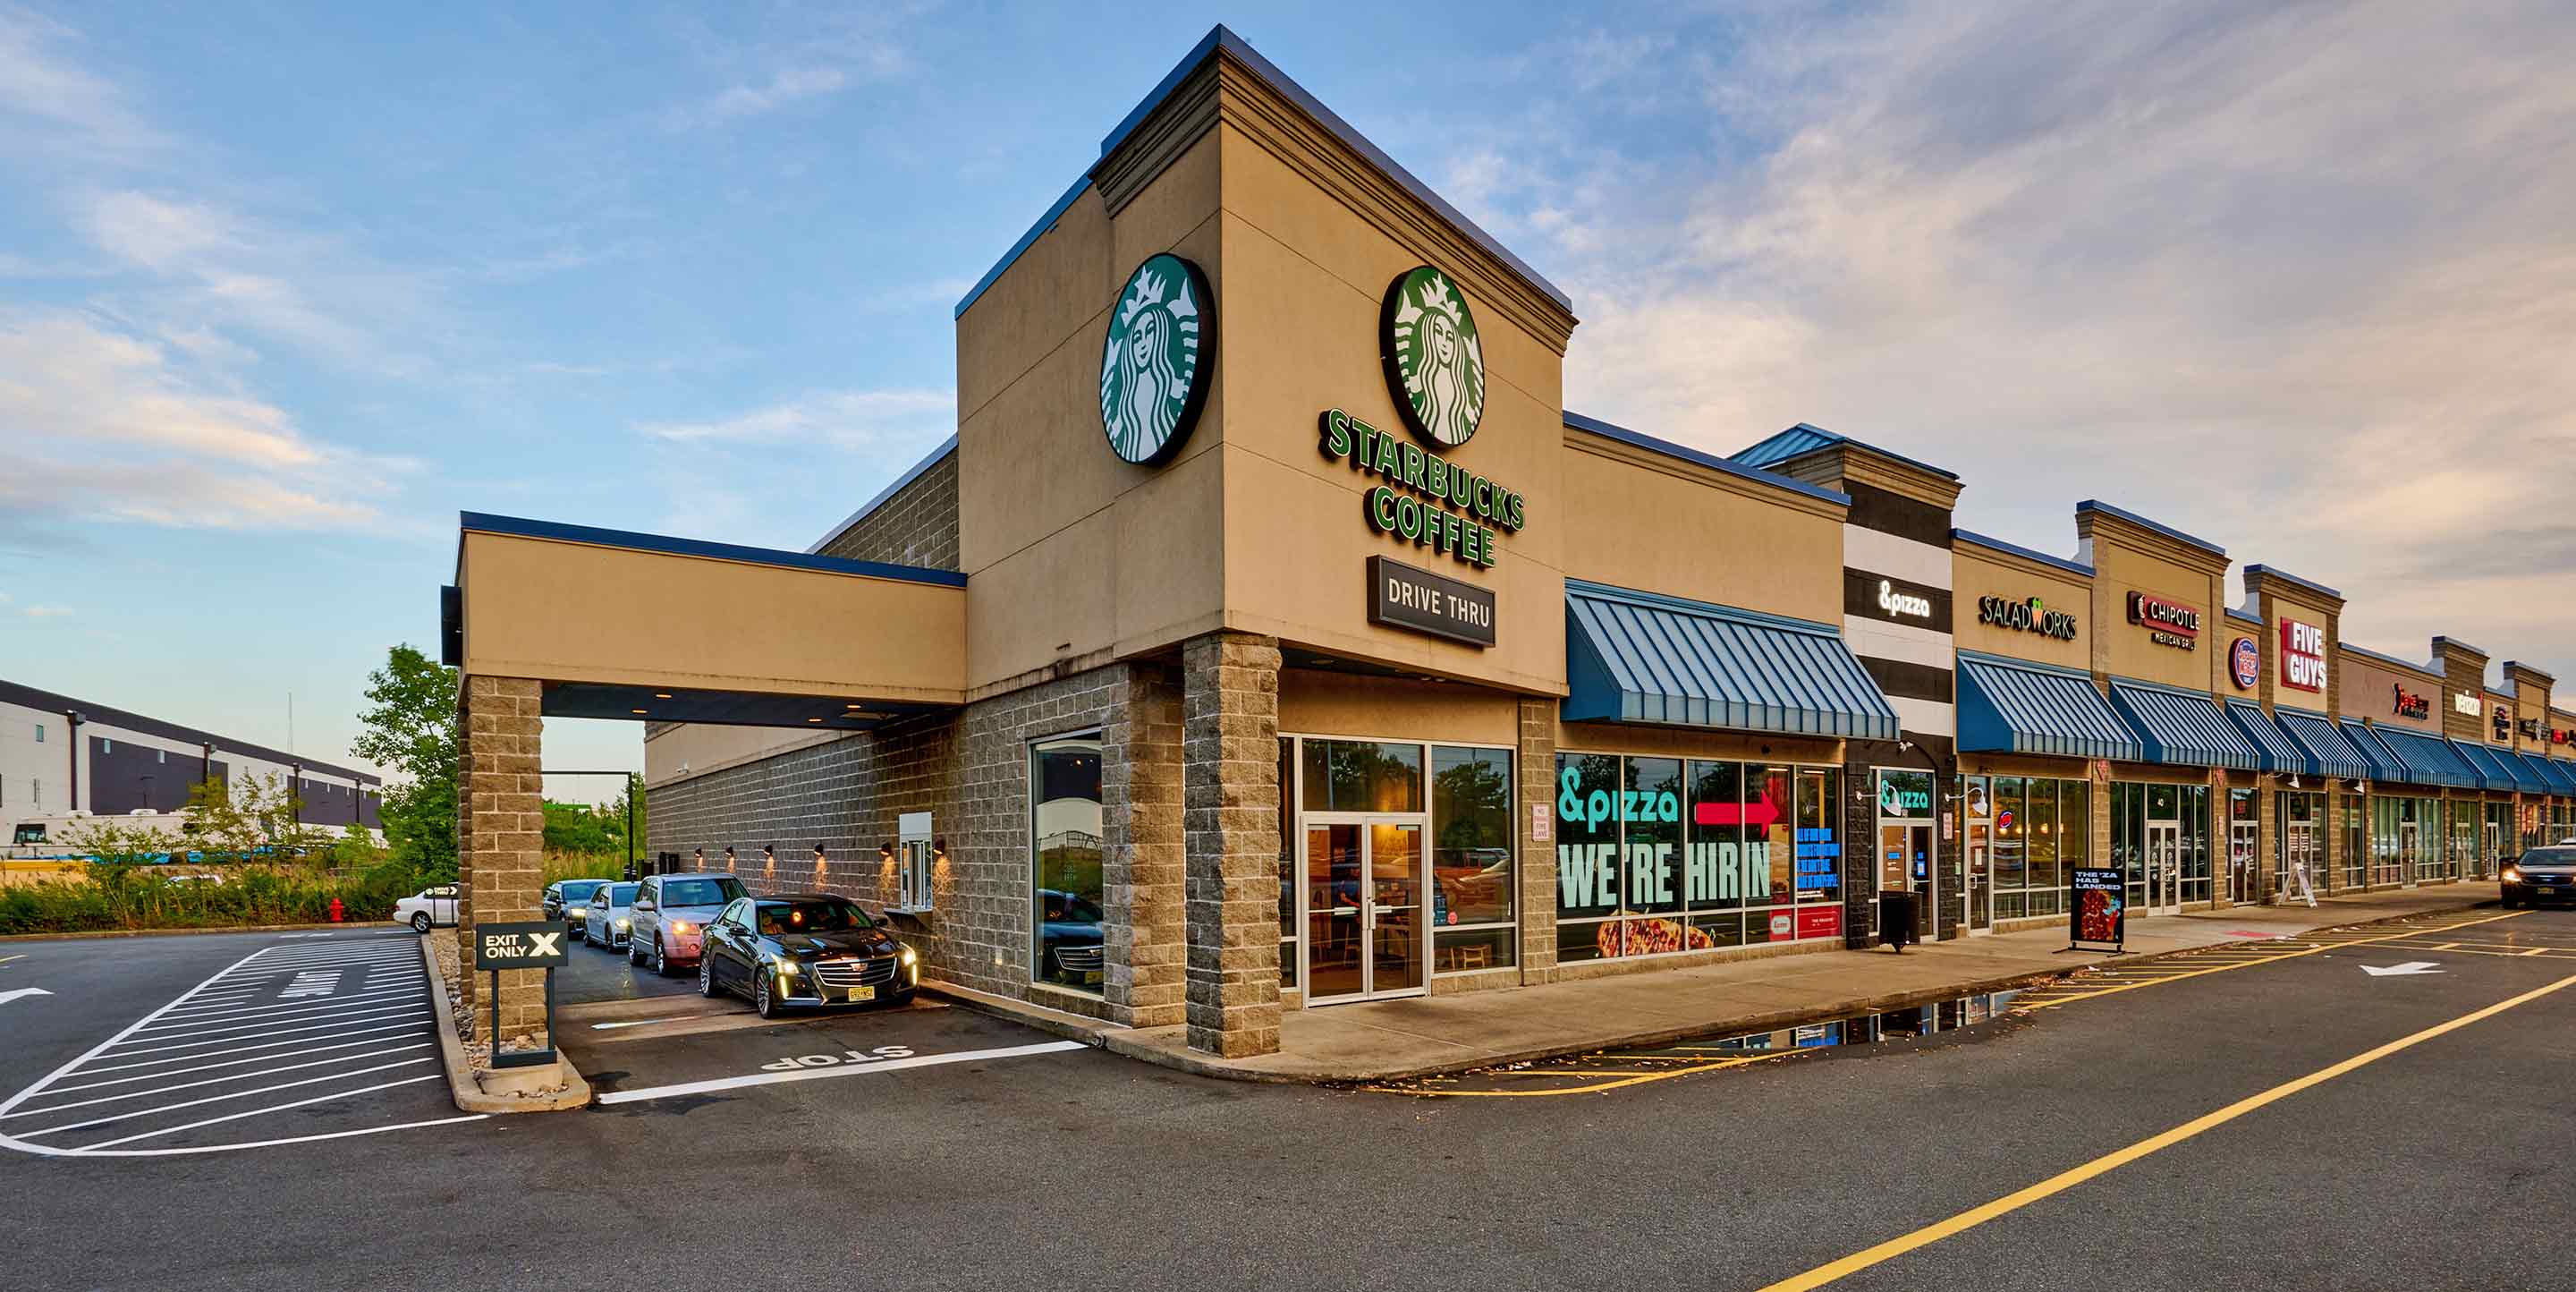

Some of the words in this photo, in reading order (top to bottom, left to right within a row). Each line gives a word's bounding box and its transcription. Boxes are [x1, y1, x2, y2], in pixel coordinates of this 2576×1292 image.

[1327, 408, 1524, 531] STARBUCKS
[1372, 486, 1496, 567] COFFEE
[1388, 578, 1441, 615] DRIVE
[1447, 594, 1489, 627] THRU
[1880, 580, 1930, 617] &pizza
[2151, 601, 2200, 630] CHIPOTLE
[1983, 596, 2076, 640] SALADWORKS
[2155, 633, 2180, 646] MEXICAN
[2292, 622, 2323, 656] FIVE
[2290, 654, 2326, 689] GUYS
[1559, 767, 1678, 833] &pizza
[1559, 843, 1674, 908] WE'RE
[486, 934, 520, 947] EXIT
[486, 946, 528, 959] ONLY
[760, 1045, 915, 1071] STOP
